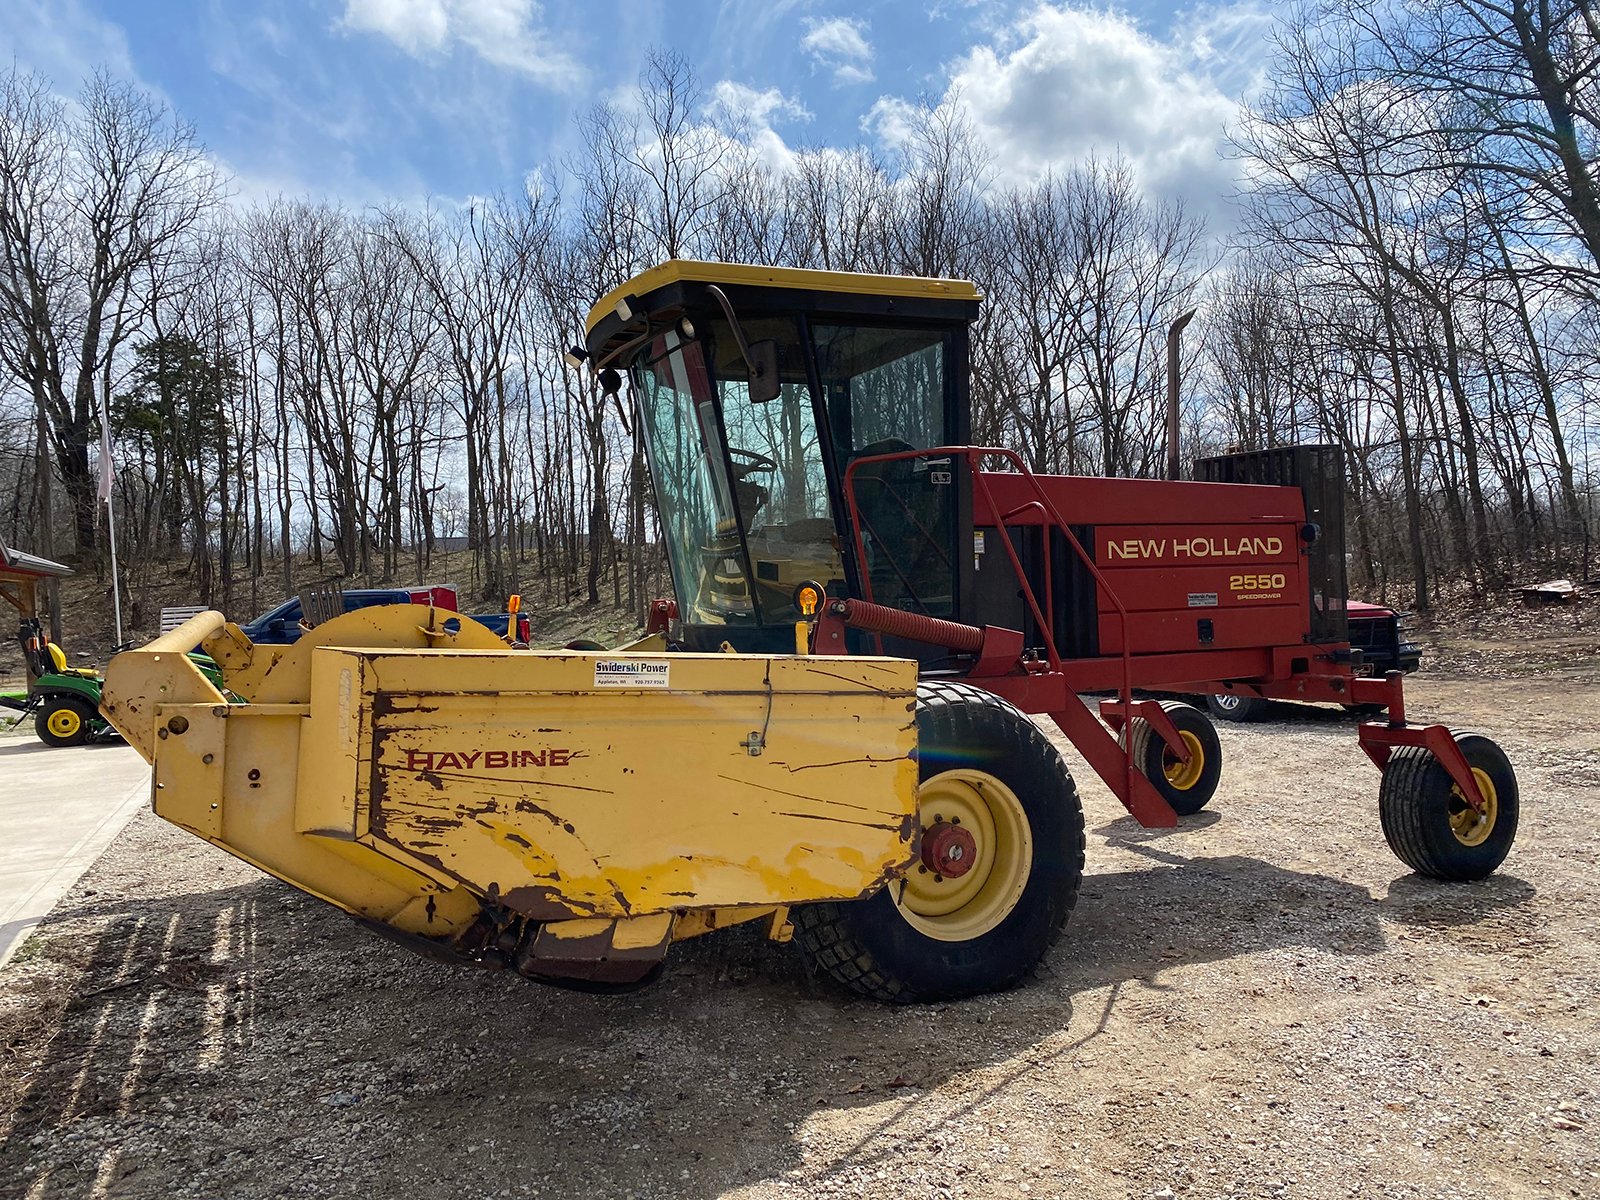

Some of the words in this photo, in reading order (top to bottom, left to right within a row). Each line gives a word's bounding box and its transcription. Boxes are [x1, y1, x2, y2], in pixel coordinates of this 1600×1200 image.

[1107, 539, 1166, 560] NEW
[1173, 537, 1283, 558] HOLLAND
[1229, 573, 1286, 590] 2550
[596, 662, 639, 672] Swiderski
[640, 663, 668, 673] Power
[407, 749, 570, 771] HAYBINE
